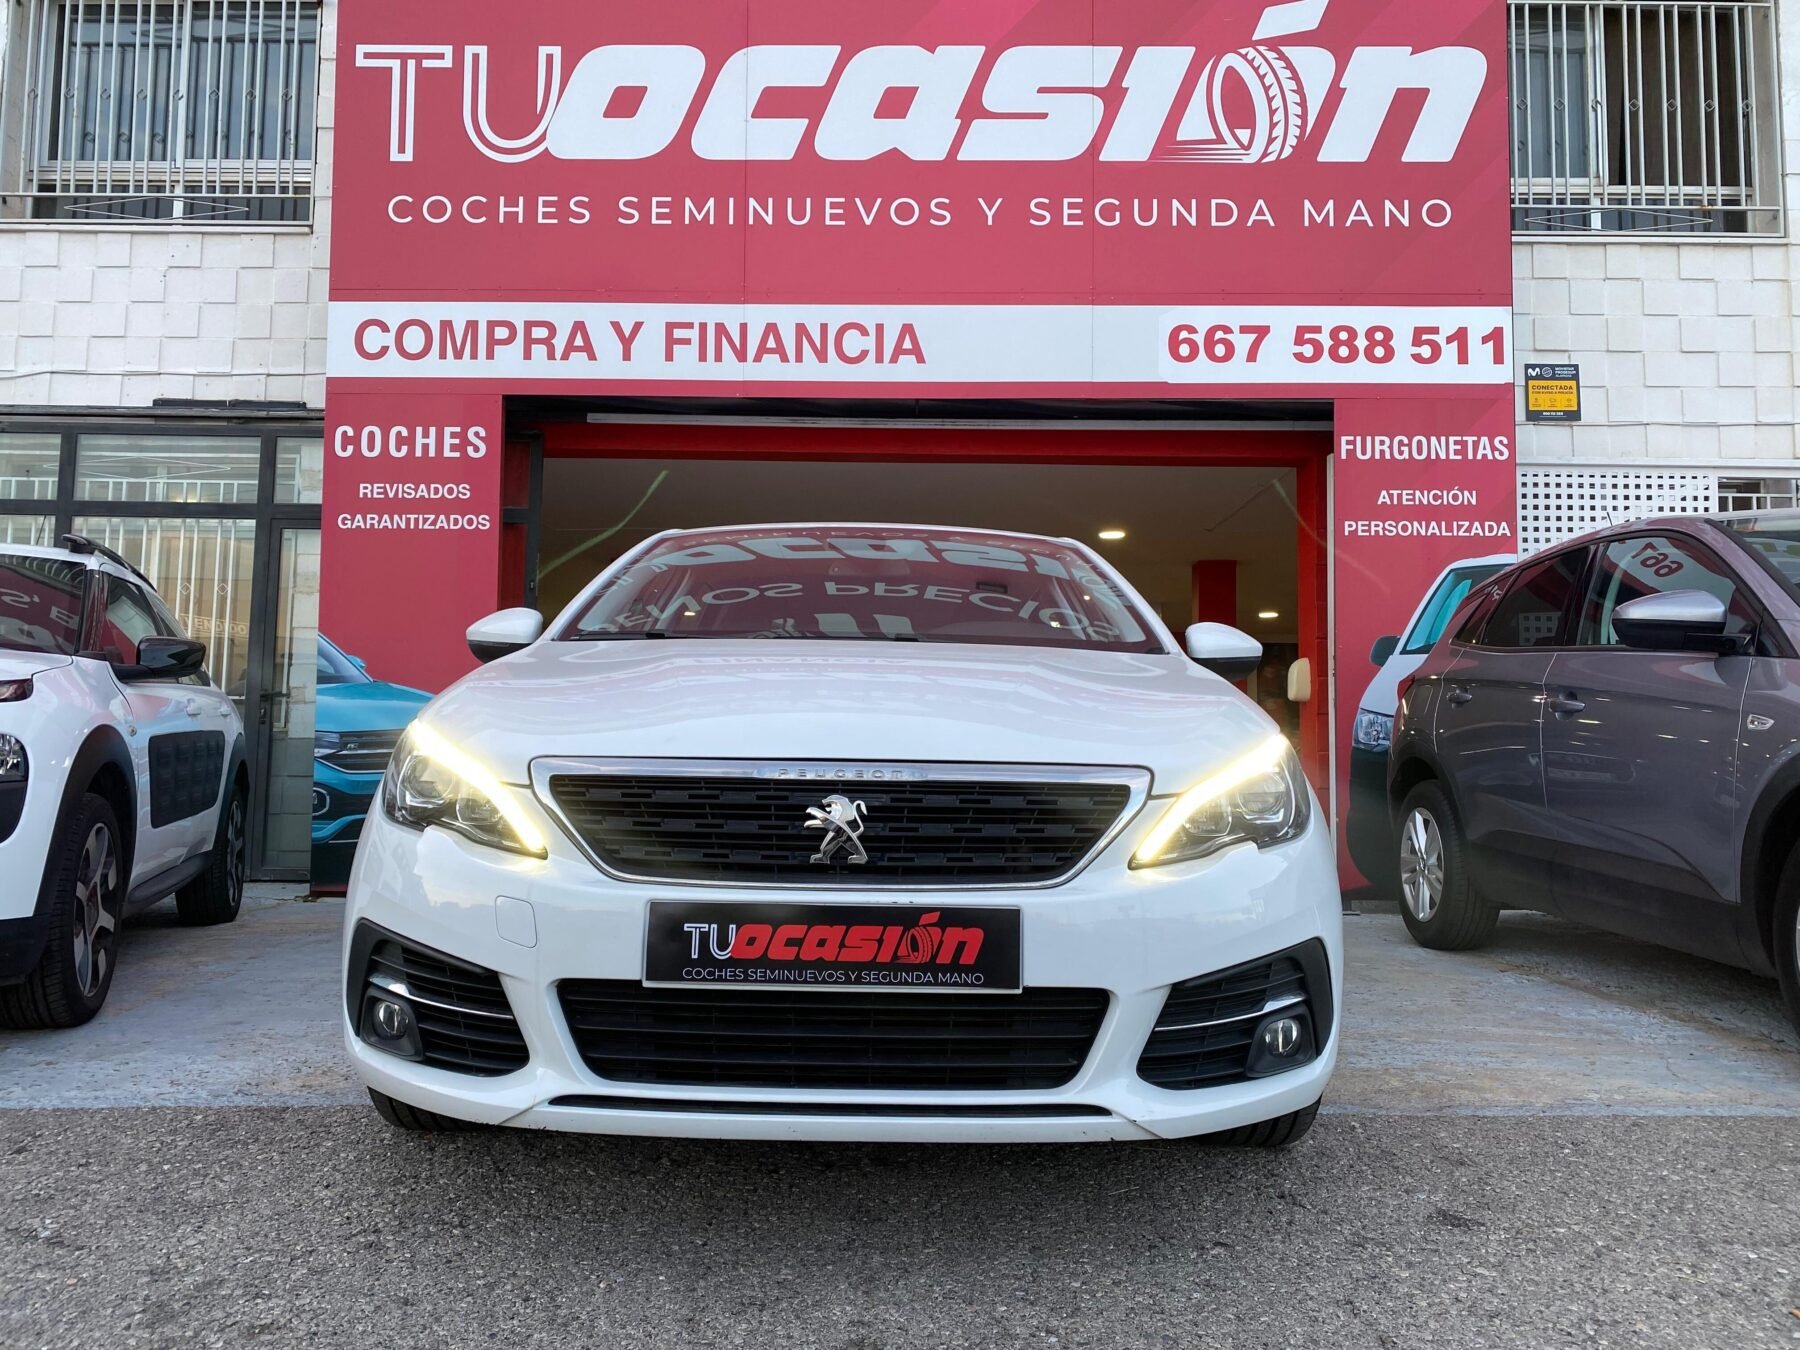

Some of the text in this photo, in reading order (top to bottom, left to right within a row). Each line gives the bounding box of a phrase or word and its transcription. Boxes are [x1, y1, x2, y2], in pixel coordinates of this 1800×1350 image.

[387, 195, 1453, 229] COCHES SEMINUEVOS Y SEGUNDA MANO
[354, 318, 926, 365] COMPRA Y FINANCIA
[1167, 323, 1505, 365] 667 588 511
[334, 425, 488, 459] COCHES
[1339, 434, 1511, 462] FURGONETAS
[358, 482, 472, 500] REVISADOS
[1377, 486, 1478, 507] ATENCIÓN
[337, 513, 491, 531] GARANTIZADOS
[1344, 520, 1512, 538] PERSONALIZADA
[777, 768, 903, 779] PEUGEOT
[682, 967, 984, 985] COCHES SEMINUEVOS Y SEGUNDA MANO
